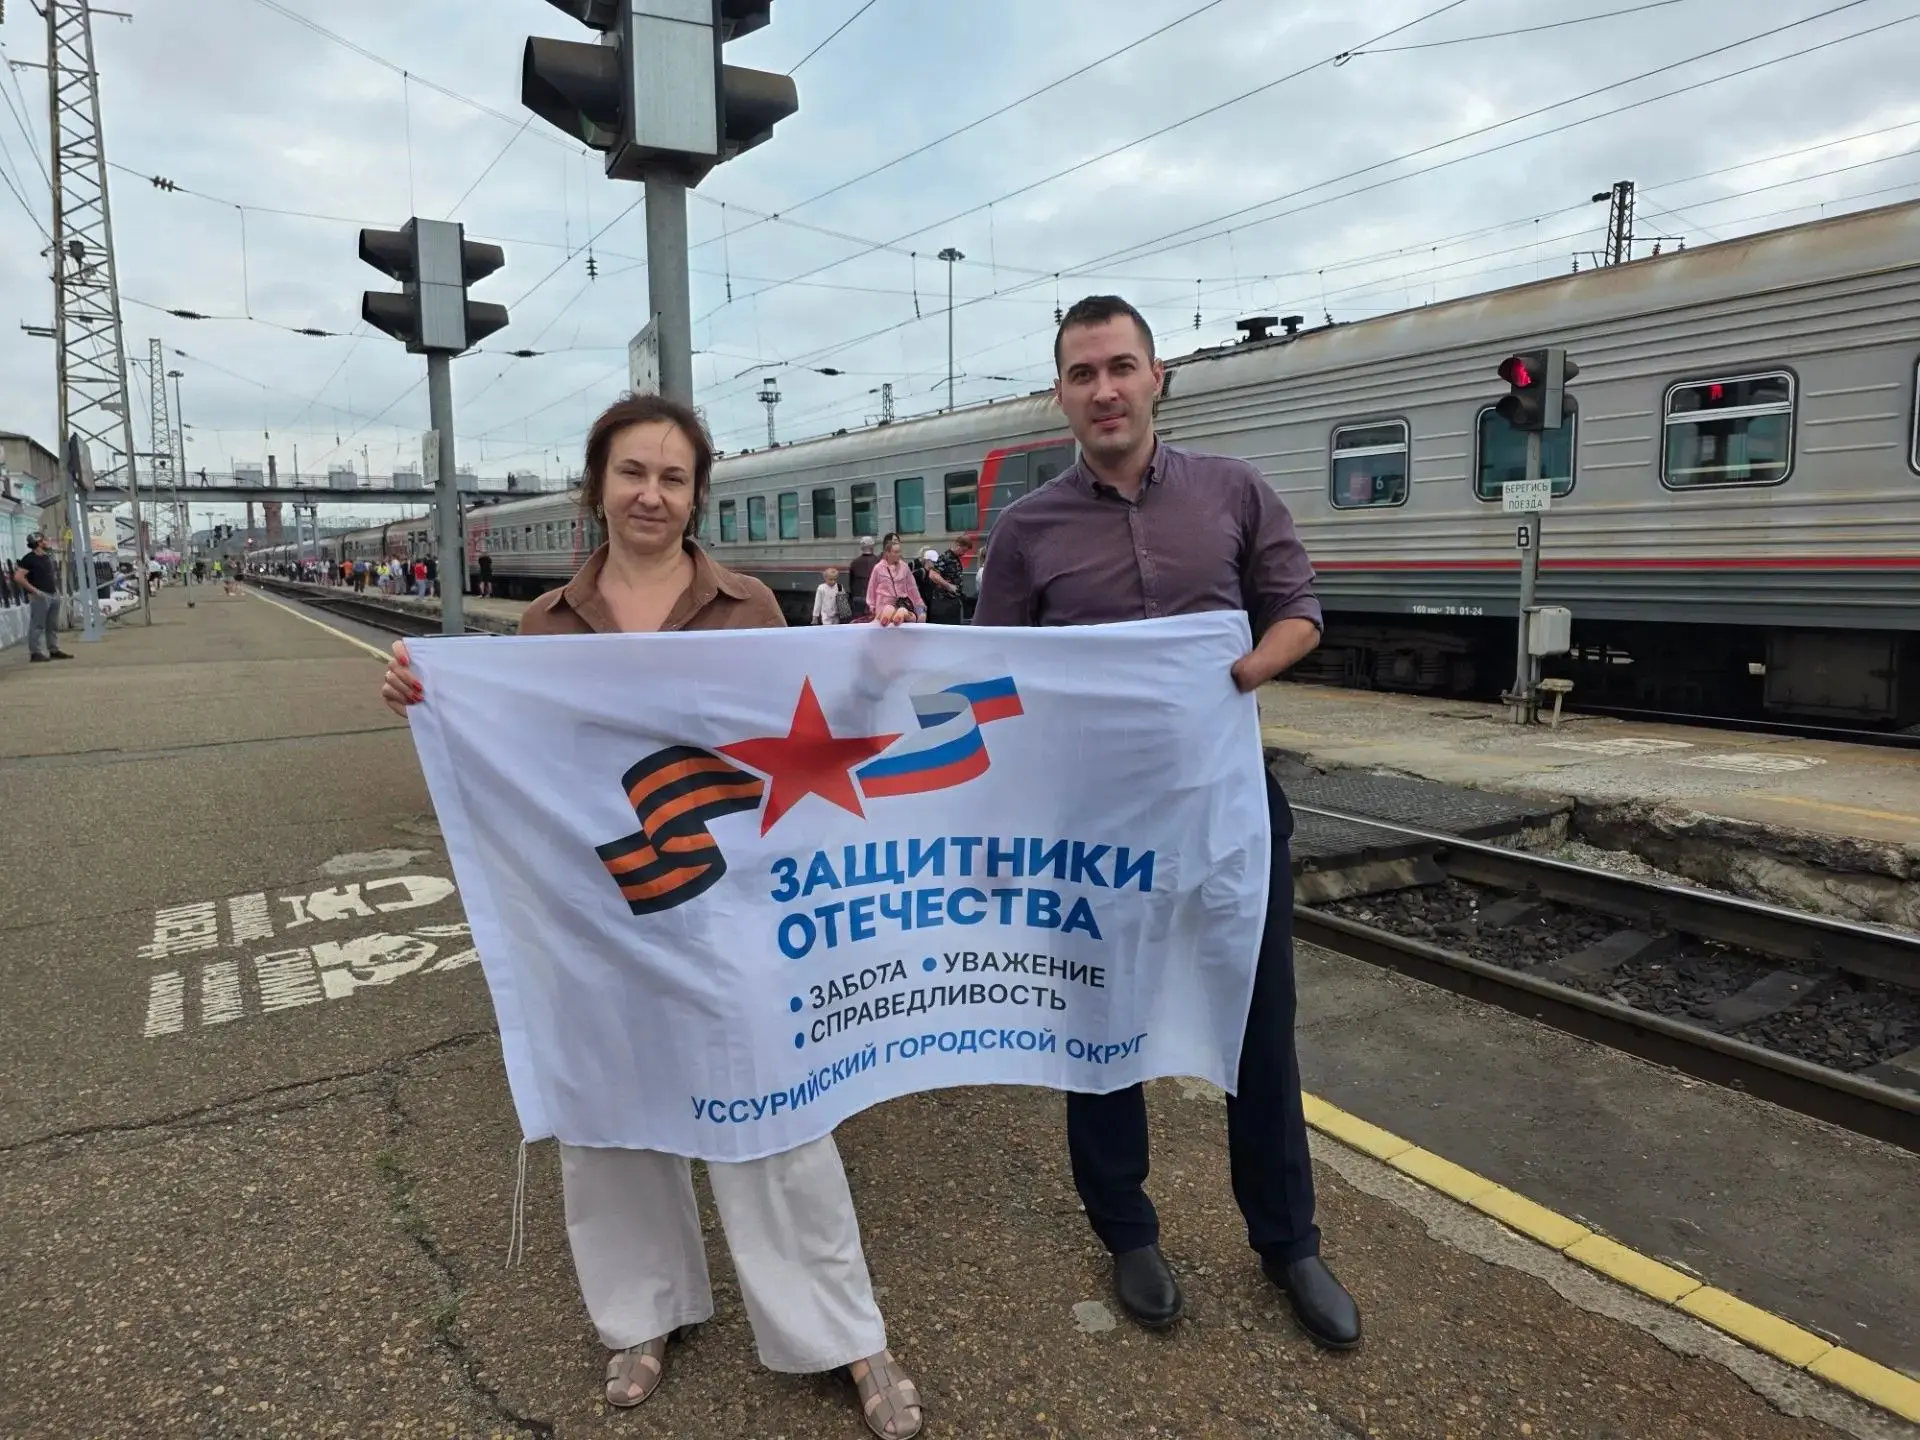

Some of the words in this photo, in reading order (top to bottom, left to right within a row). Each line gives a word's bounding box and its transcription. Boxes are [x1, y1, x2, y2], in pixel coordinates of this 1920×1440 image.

[1505, 482, 1549, 494] БЕРЕГИСЬ
[1508, 499, 1543, 510] ПОЕЗДА
[769, 835, 1156, 903] ЗАЩИТНИКИ
[776, 886, 1104, 960] ОТЕЧЕСТВА
[809, 959, 908, 1010] ЗАБОТА
[943, 952, 1106, 989] УВАЖЕНИЕ
[810, 983, 1067, 1043] СПРАВЕДЛИВОСТЬ
[690, 1043, 878, 1125] УССУРИЙСКИЙ
[885, 1028, 1057, 1065] ГОРОДСКОЙ
[1065, 1032, 1148, 1065] ОКРУГ
